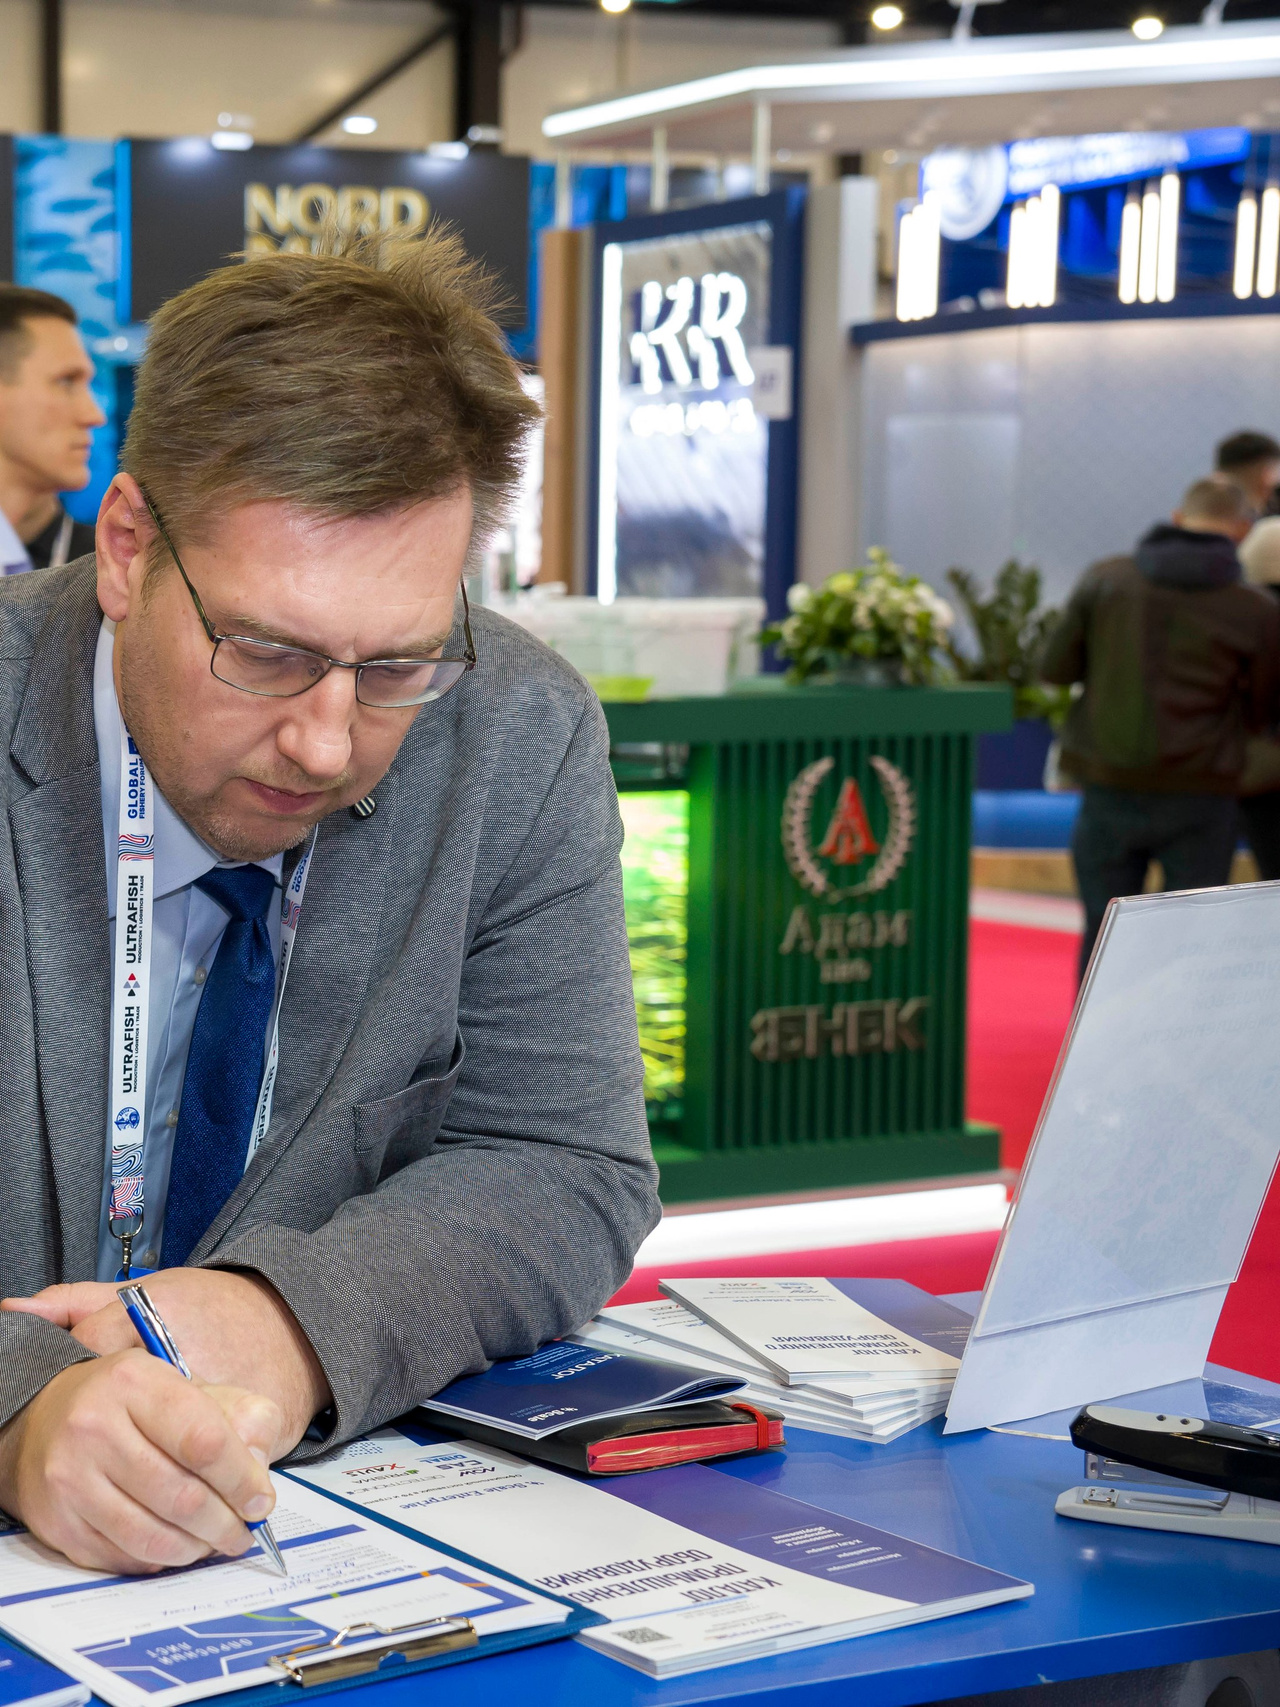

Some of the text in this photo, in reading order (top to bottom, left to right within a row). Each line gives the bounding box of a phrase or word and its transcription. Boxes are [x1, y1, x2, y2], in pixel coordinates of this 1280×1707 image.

[243, 180, 430, 237] NORD
[127, 758, 139, 819] GLOBAL
[126, 875, 138, 964] ULTRAFISH
[123, 1006, 135, 1093] ULTRAFISH
[764, 1341, 910, 1351] ПРОМЫШЛЕННОГО
[772, 1333, 898, 1342] ОБОРУДОВАНИЯ
[399, 1480, 528, 1510] Scale Enterprise
[534, 1549, 714, 1589] ОБОРУДОВАНИЯ
[567, 1562, 749, 1604] ПРОМЫШЛЕННО
[679, 1575, 783, 1603] КАТАЛОГ
